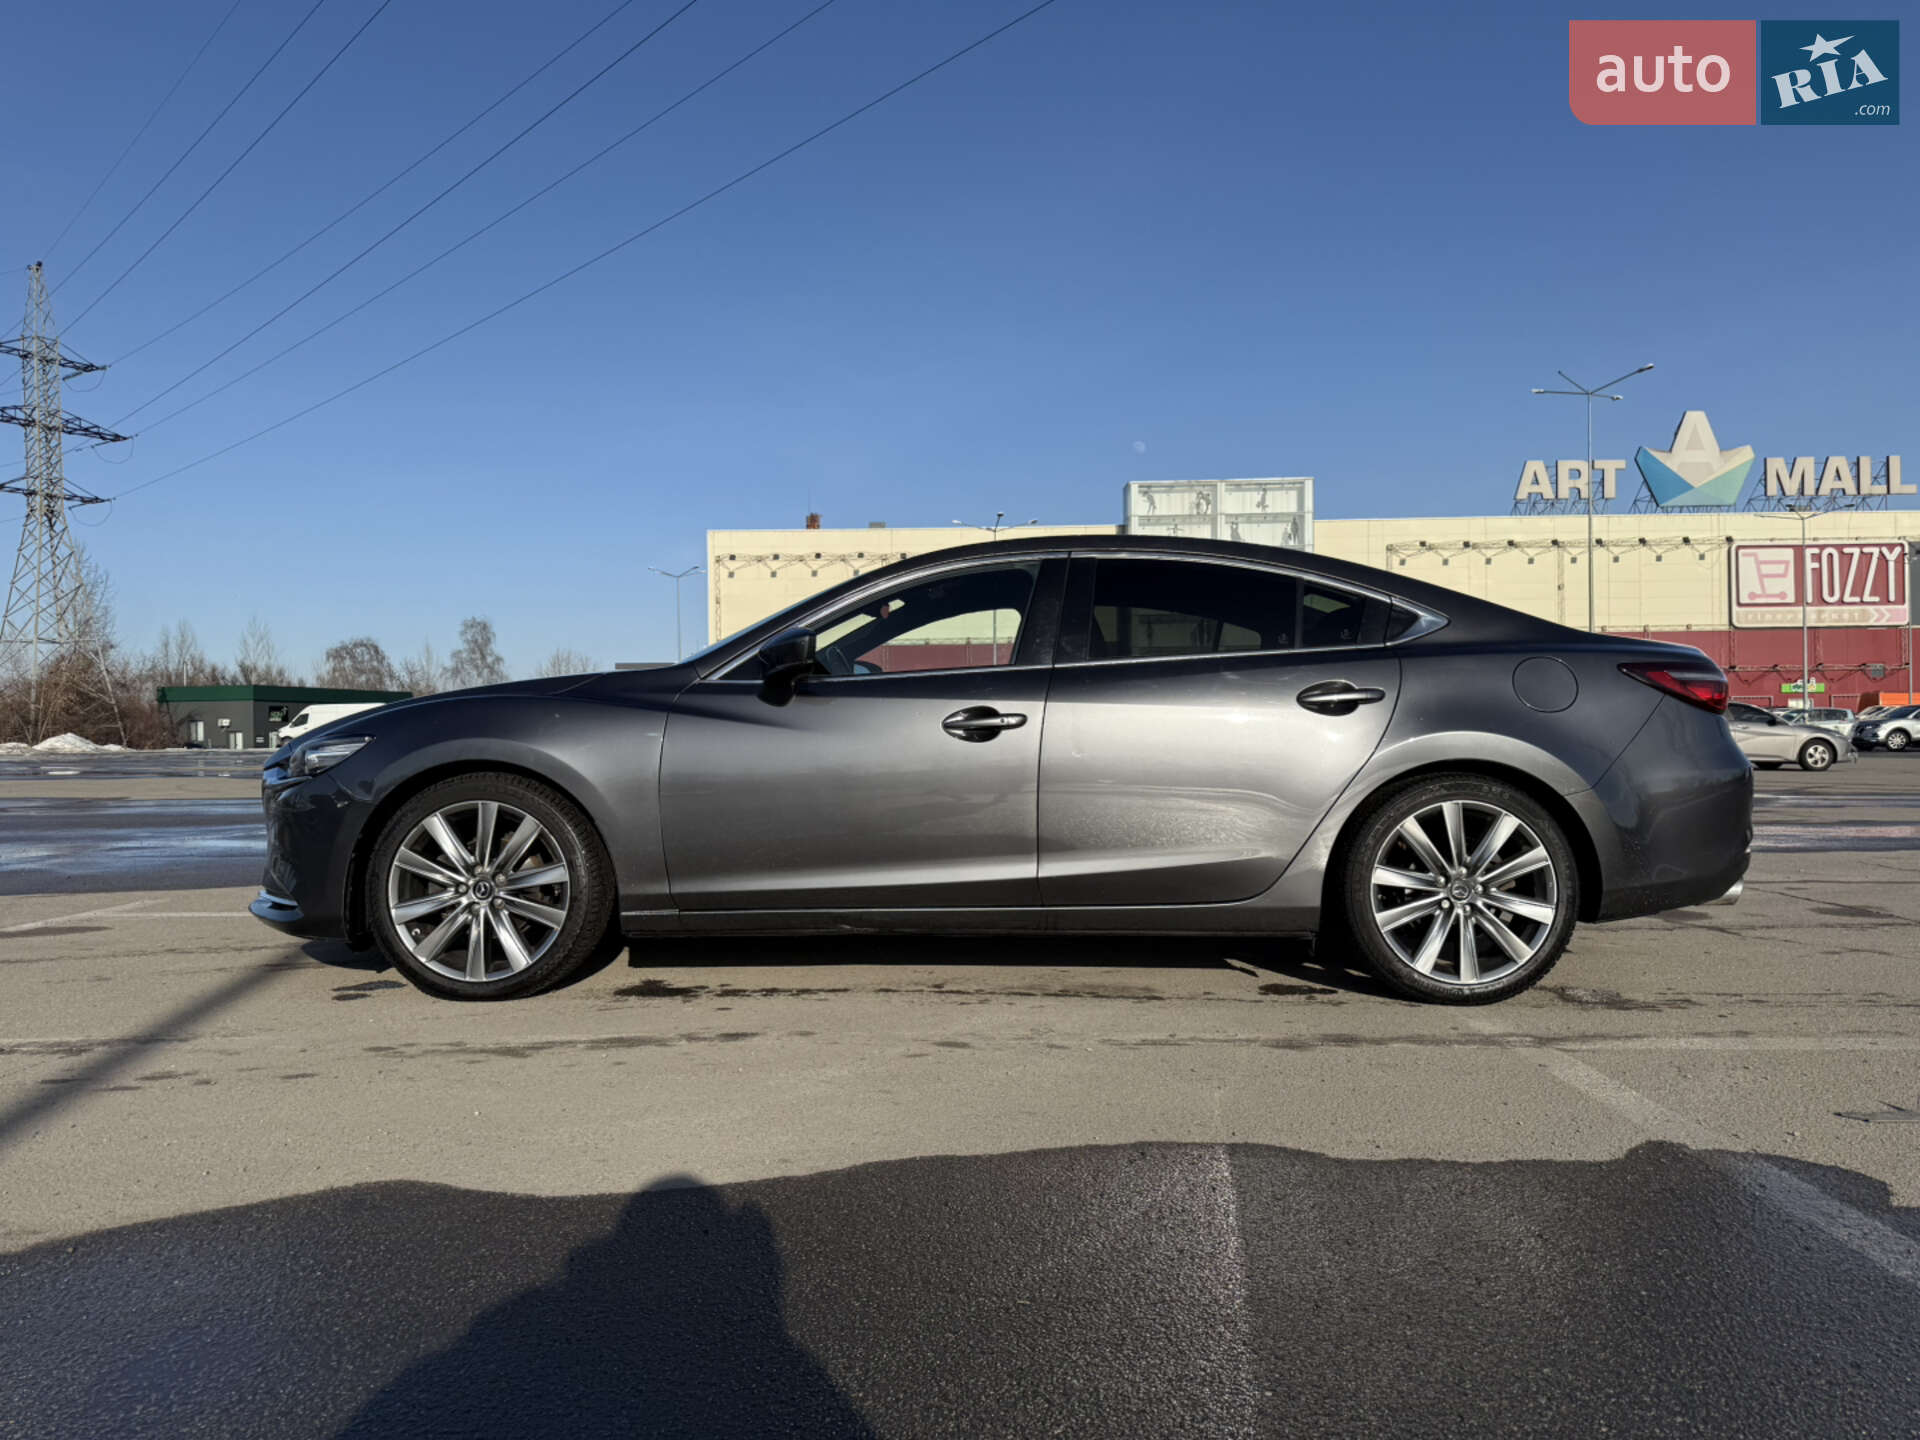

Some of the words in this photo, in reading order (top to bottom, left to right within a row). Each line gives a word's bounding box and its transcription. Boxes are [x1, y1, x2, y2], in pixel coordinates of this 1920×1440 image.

[1515, 459, 1627, 500] ART
[1765, 455, 1918, 497] MALL
[1804, 545, 1902, 604] FOZZY
